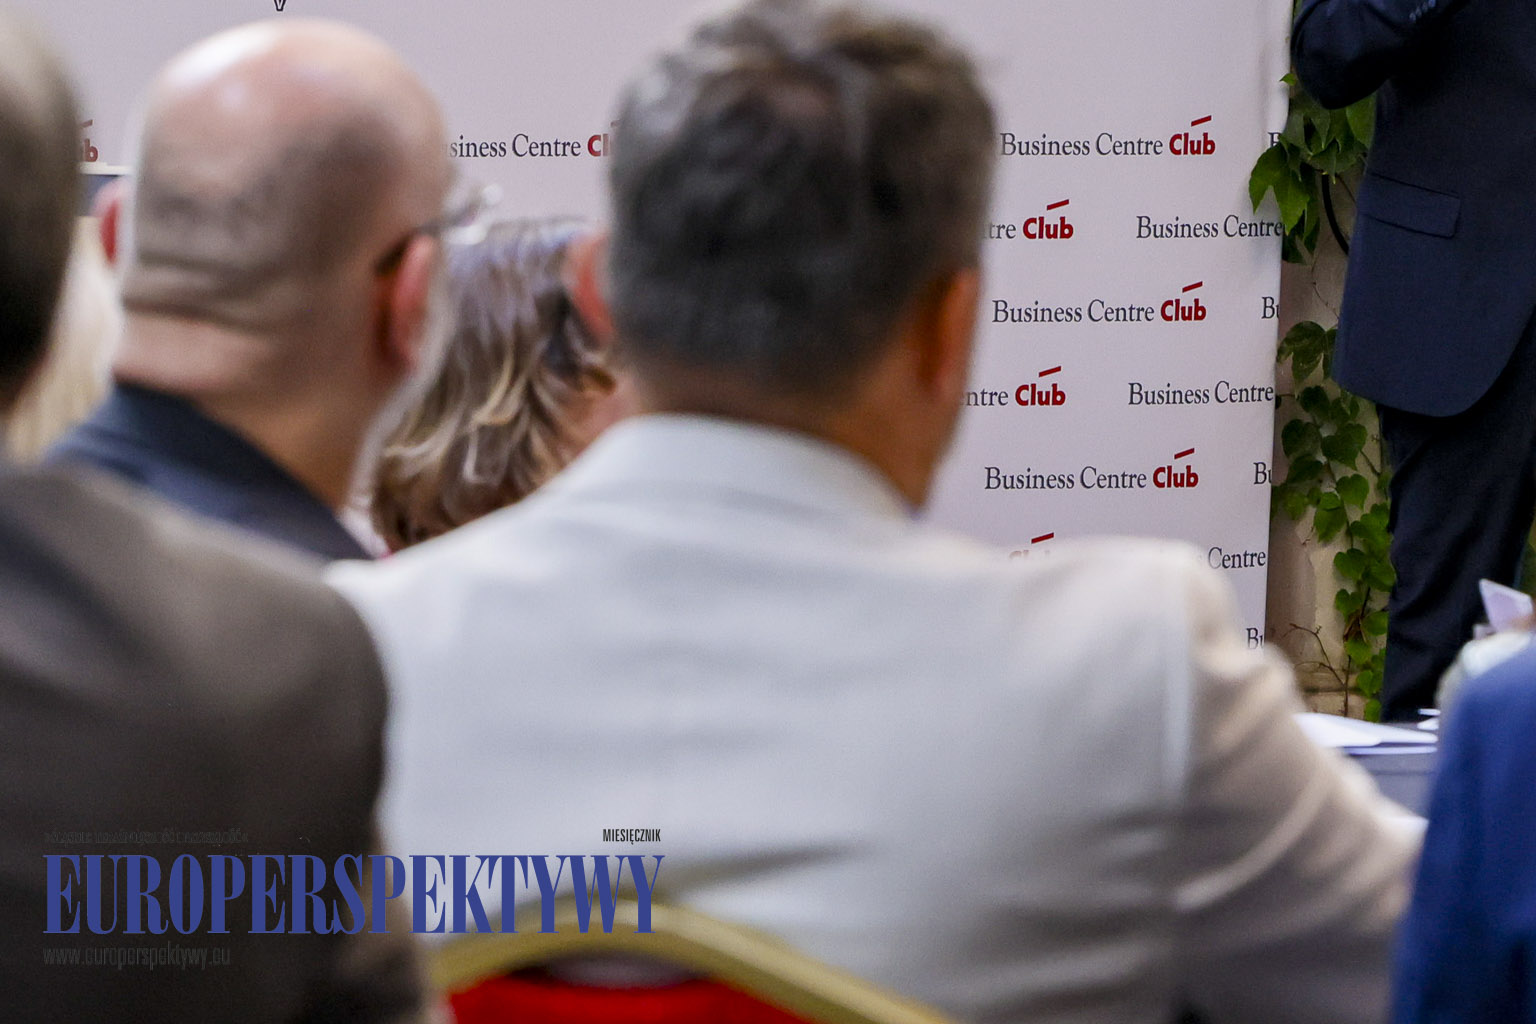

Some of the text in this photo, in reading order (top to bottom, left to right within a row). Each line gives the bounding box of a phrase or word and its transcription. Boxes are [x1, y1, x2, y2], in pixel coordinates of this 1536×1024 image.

[512, 133, 581, 158] Centre
[1000, 132, 1215, 156] Business Centre Club
[1023, 216, 1074, 239] Club
[1136, 215, 1282, 238] Business Centre
[992, 298, 1206, 323] Business Centre Club
[966, 383, 1066, 406] ntre Club
[1128, 381, 1274, 405] Business Centre
[984, 465, 1198, 490] Business Centre Club
[1208, 547, 1266, 569] Centre
